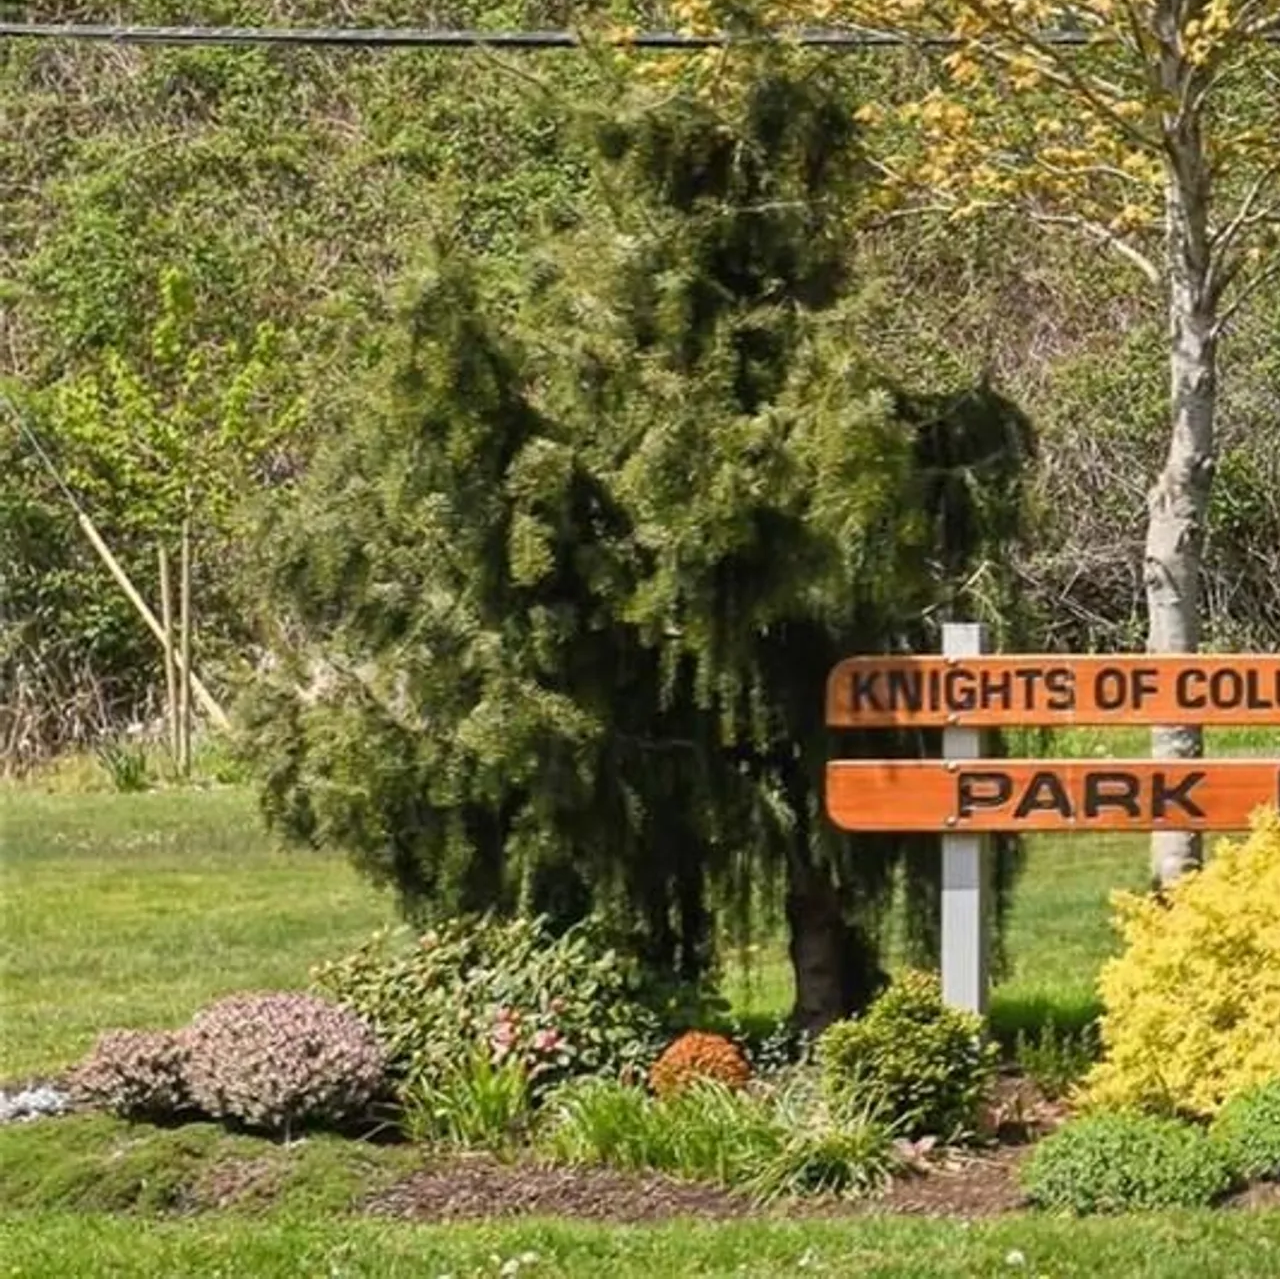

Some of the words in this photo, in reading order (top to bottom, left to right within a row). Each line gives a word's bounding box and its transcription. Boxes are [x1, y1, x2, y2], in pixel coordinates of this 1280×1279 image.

[851, 668, 1076, 712] KNIGHTS
[1094, 669, 1160, 712] OF
[954, 771, 1208, 820] PARK
